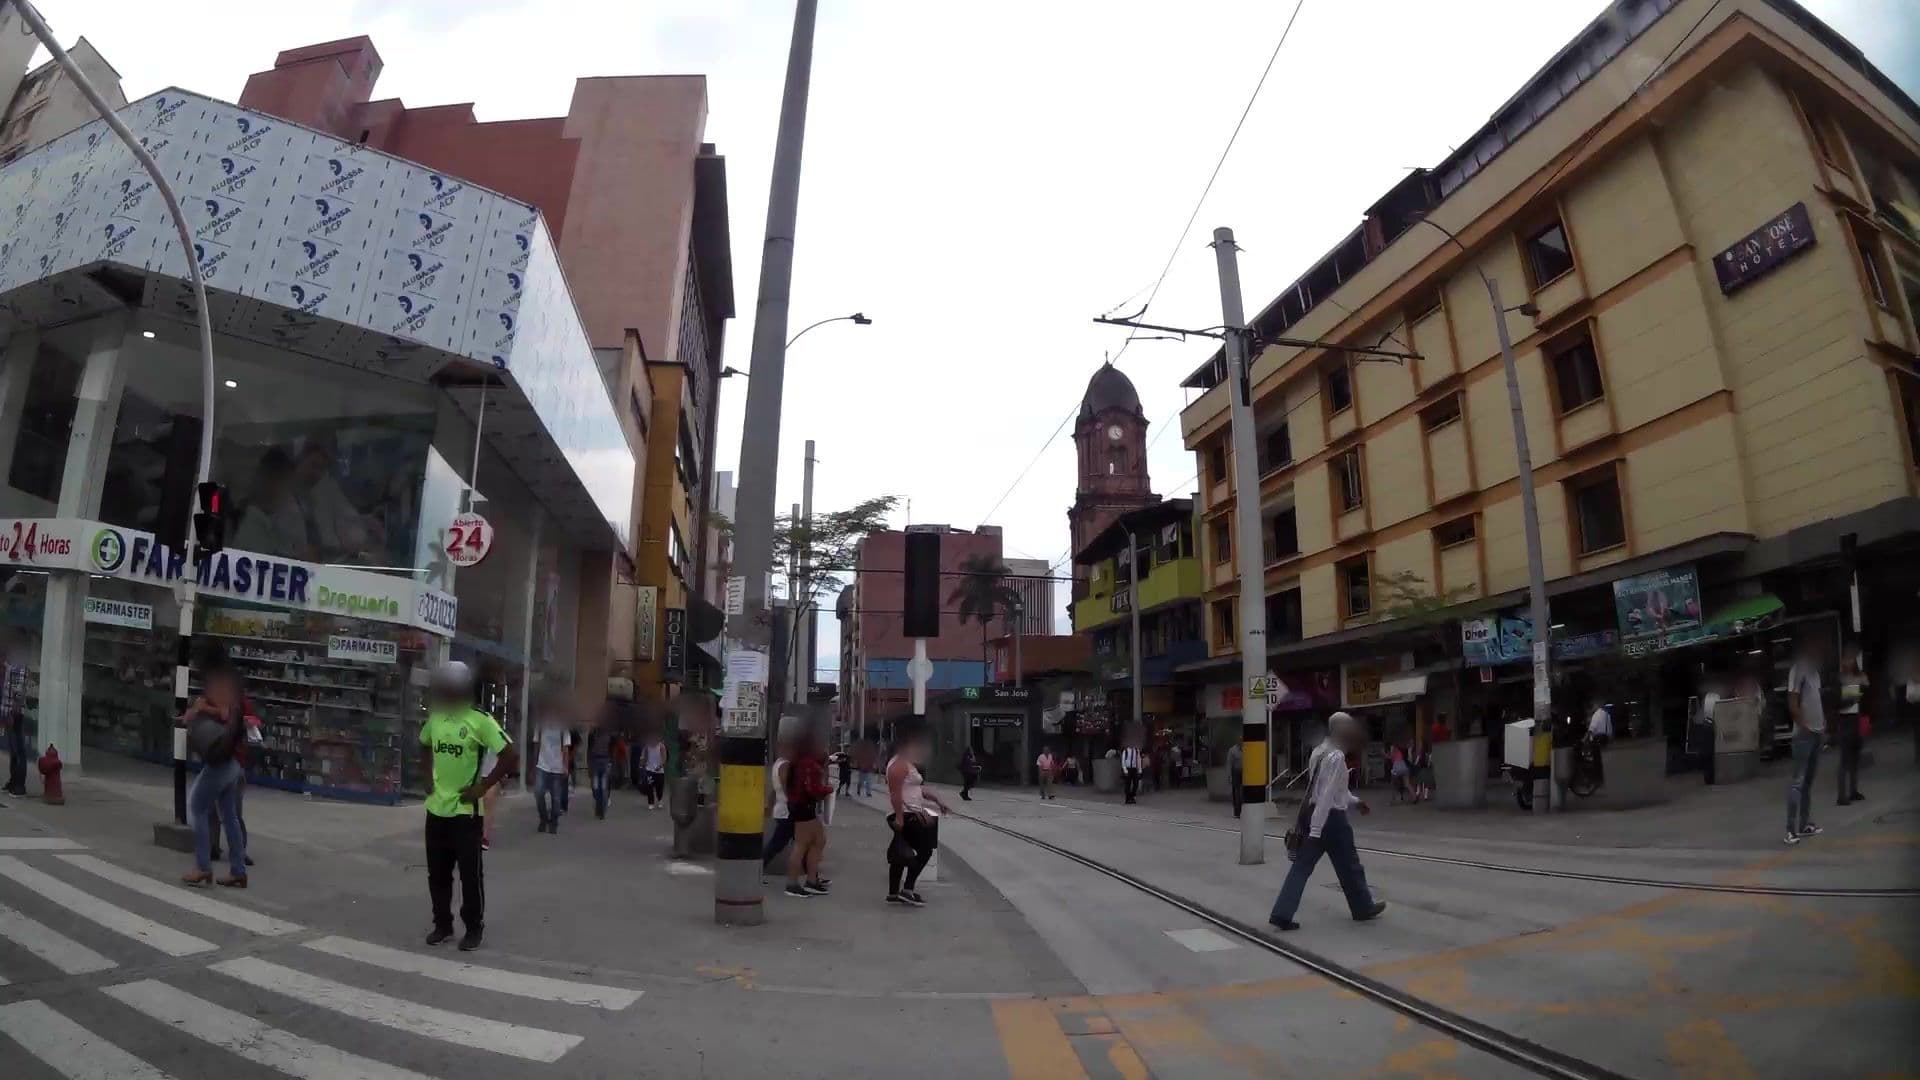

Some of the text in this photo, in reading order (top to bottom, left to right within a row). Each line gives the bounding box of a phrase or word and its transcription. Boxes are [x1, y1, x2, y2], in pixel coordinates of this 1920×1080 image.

[242, 138, 262, 153] ACP
[227, 178, 247, 195] ACP
[439, 195, 456, 210] ACP
[213, 221, 232, 239] ACP
[324, 220, 342, 236] ACP
[428, 234, 445, 249] ACP
[1740, 232, 1798, 273] HOTEL
[312, 263, 330, 280] ACP
[419, 275, 436, 291] ACP
[409, 318, 426, 335] ACP
[453, 519, 484, 528] Abierto
[9, 522, 37, 560] 24
[40, 533, 71, 555] Horas
[446, 527, 484, 552] 24
[95, 600, 150, 620] FARMASTER
[341, 639, 394, 656] FARMASTER
[667, 611, 680, 669] HOTEL
[1266, 677, 1278, 688] 25
[995, 689, 1009, 697] San
[434, 740, 463, 758] Jeep
